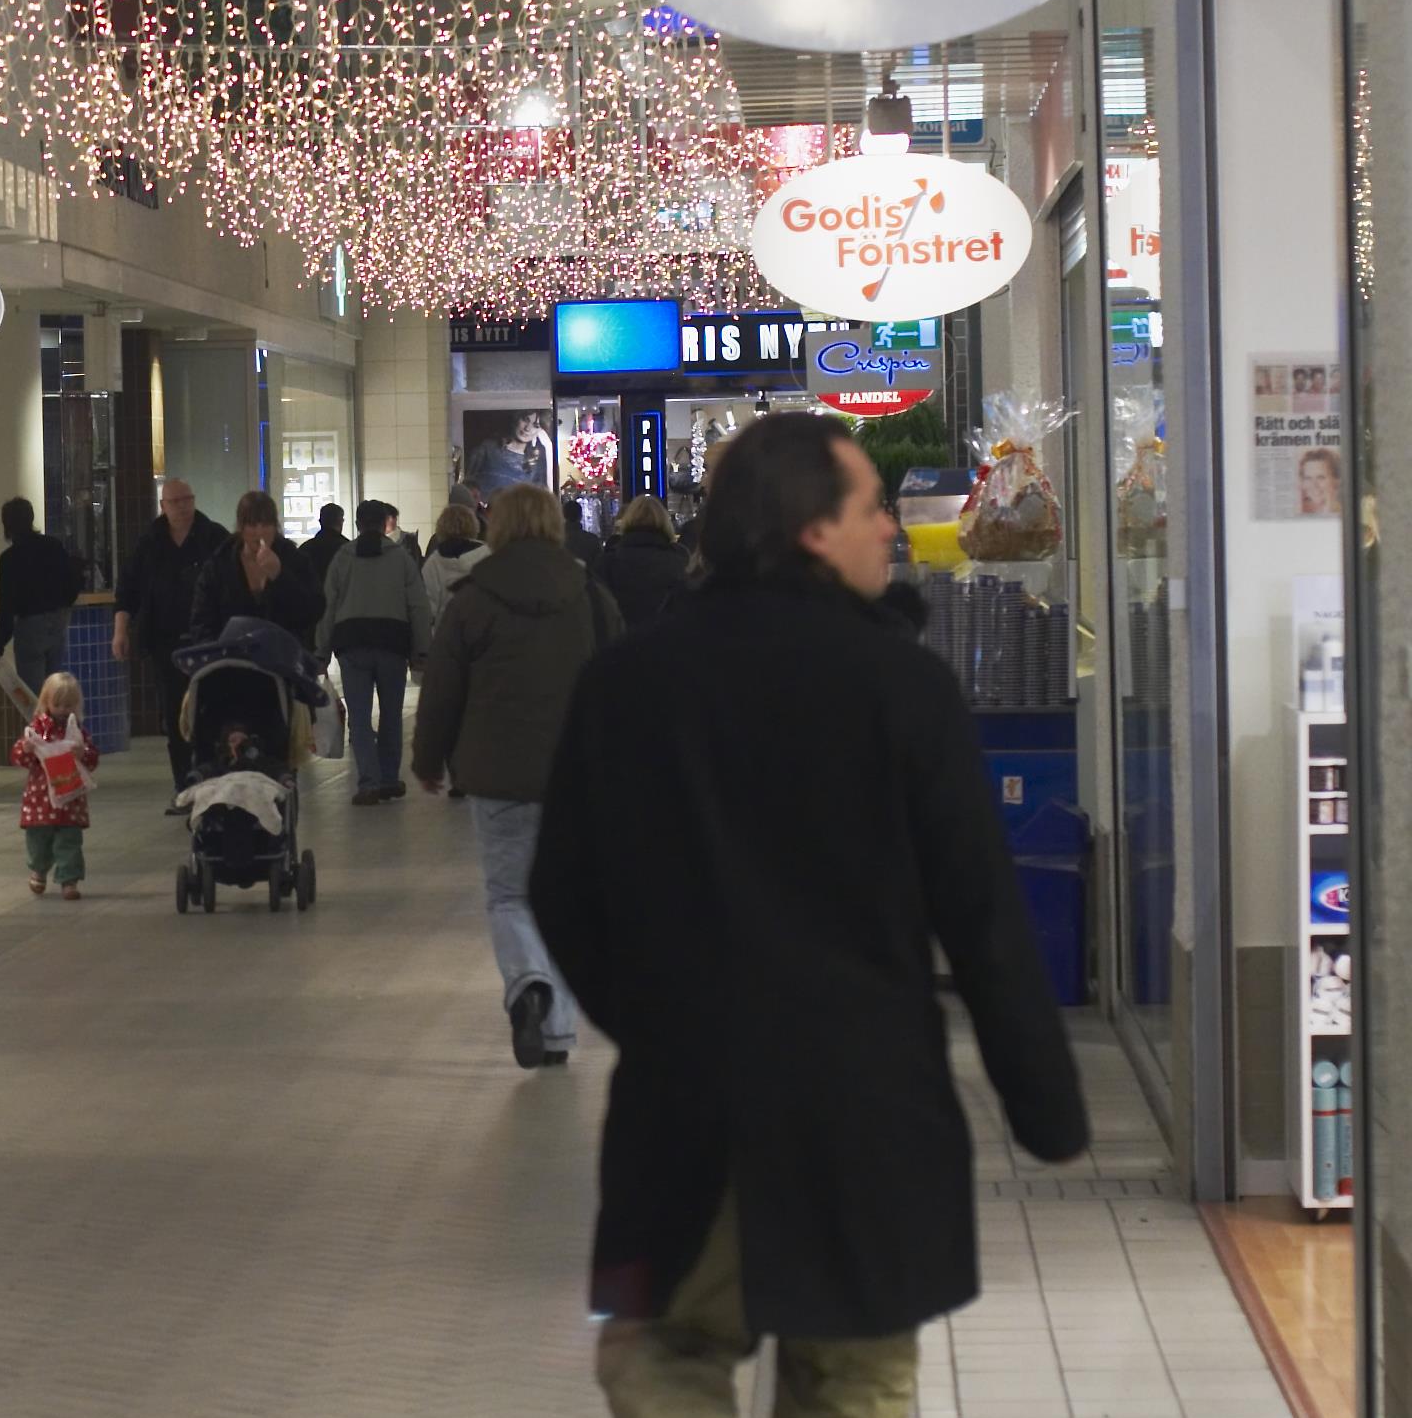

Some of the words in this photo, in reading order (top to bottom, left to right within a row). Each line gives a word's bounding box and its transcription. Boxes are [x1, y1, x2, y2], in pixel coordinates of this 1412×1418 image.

[780, 195, 904, 232] Godis
[837, 228, 1004, 268] Fönstret
[760, 323, 850, 360] NY
[816, 341, 930, 386] Crispin
[838, 390, 902, 405] HANDEL
[1254, 415, 1284, 431] Rätt
[1288, 415, 1315, 431] och
[1254, 432, 1312, 447] krämen
[642, 420, 652, 497] PARI
